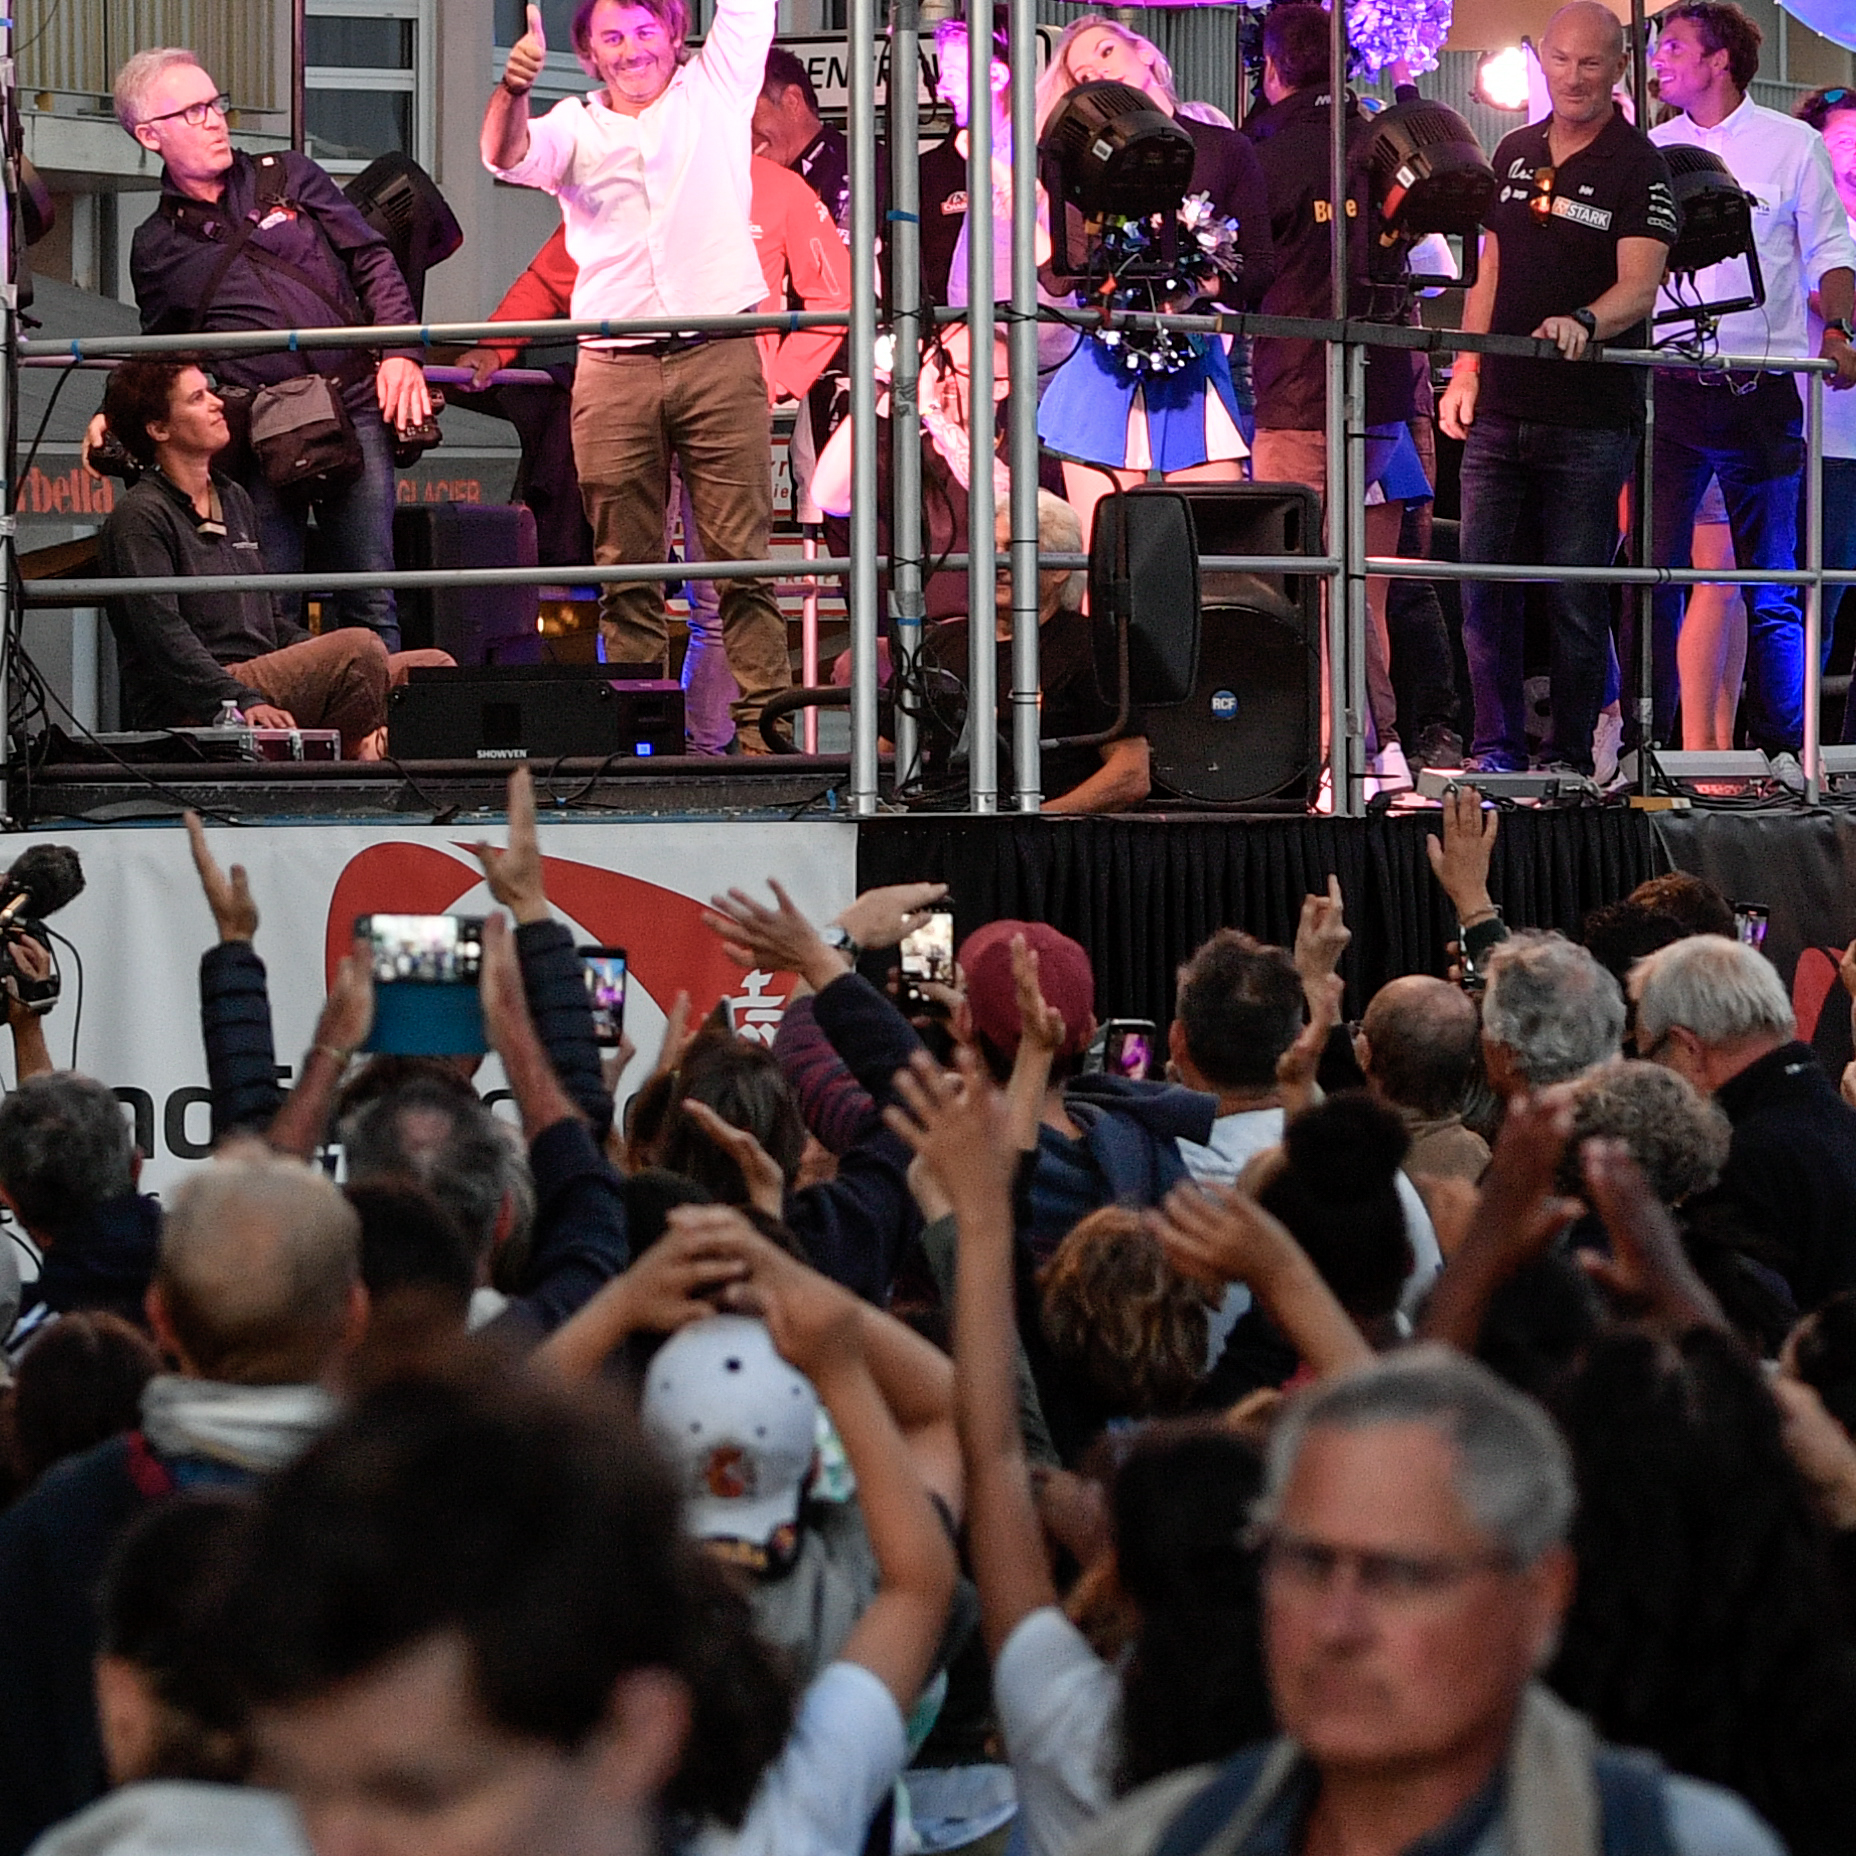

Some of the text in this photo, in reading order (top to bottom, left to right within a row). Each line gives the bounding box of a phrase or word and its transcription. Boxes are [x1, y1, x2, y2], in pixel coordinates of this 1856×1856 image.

[1567, 204, 1608, 228] STARK
[1212, 697, 1236, 711] RCF
[476, 748, 528, 759] SHOWVEN
